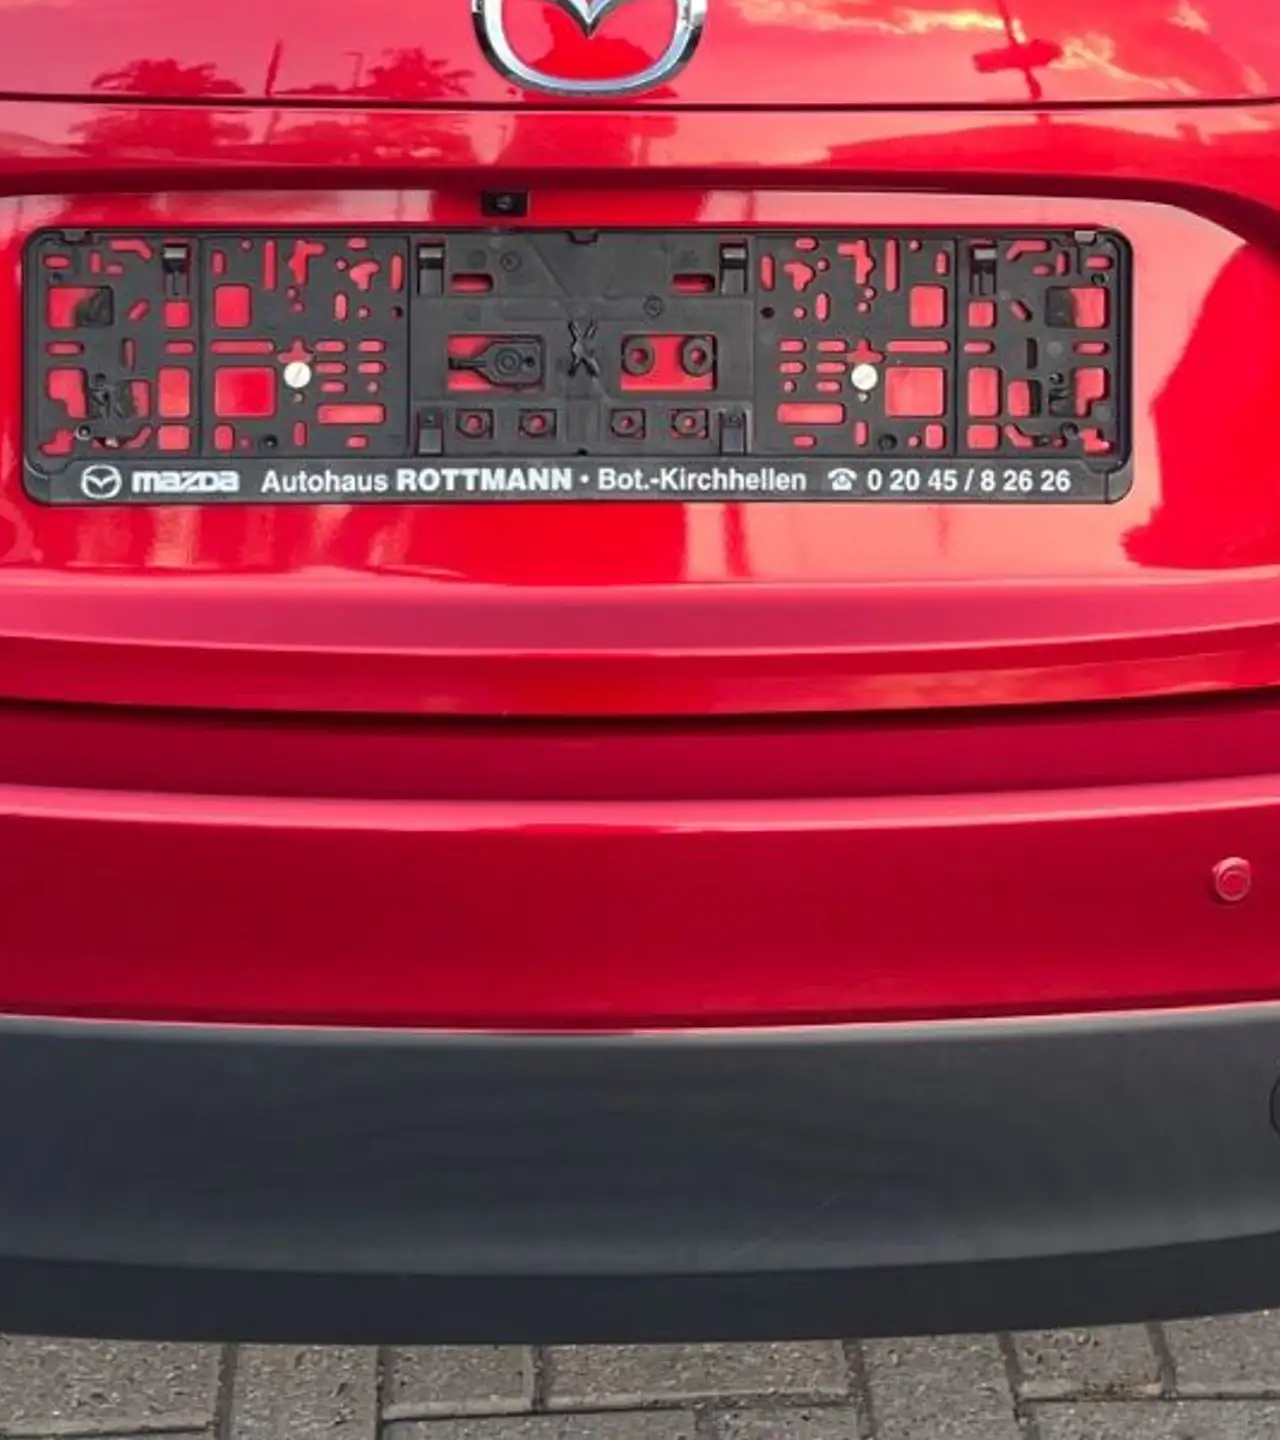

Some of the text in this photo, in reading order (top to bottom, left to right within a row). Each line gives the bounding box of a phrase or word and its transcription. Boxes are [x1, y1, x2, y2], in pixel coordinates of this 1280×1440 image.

[260, 468, 389, 494] Autohaus
[396, 466, 573, 493] ROTTMANN
[598, 466, 808, 492] Bot.-Kirchhellen
